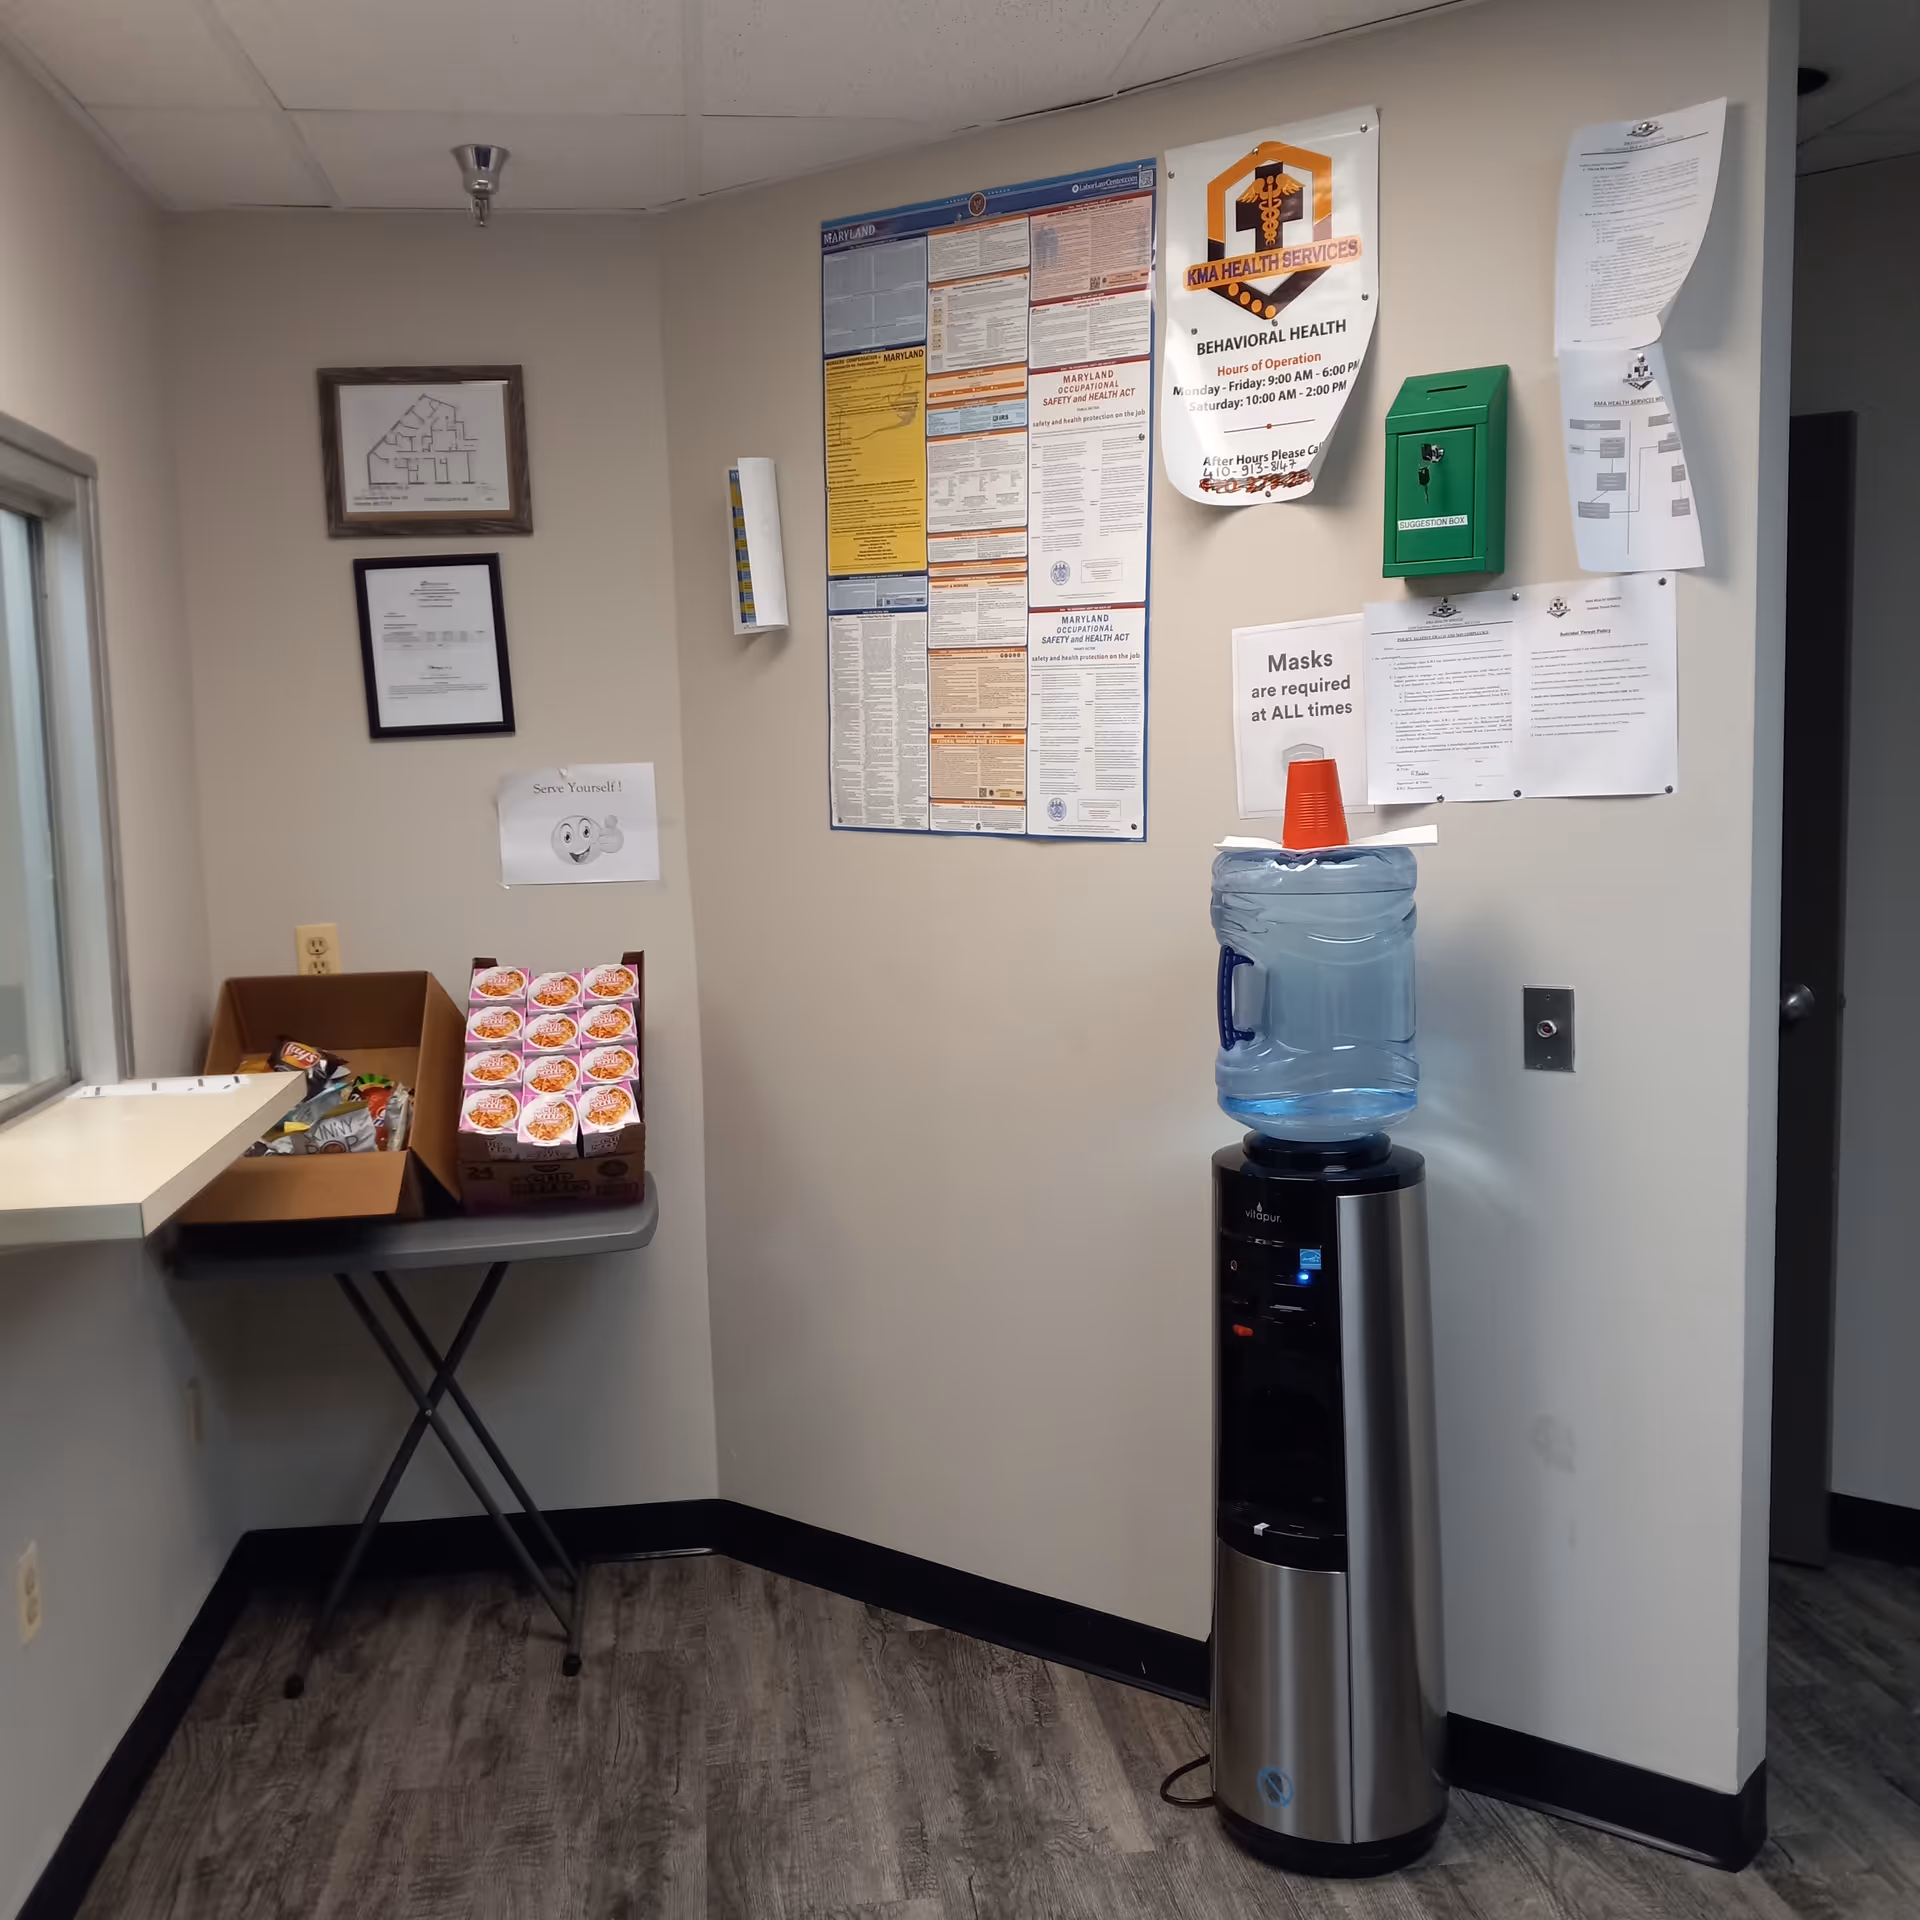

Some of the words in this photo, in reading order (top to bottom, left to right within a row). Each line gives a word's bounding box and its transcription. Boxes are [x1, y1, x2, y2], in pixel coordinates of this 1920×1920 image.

[824, 224, 876, 245] MARYLAND
[1186, 269, 1218, 287] KMA
[1221, 254, 1280, 280] HEALTH
[1282, 239, 1358, 268] SERVICES
[1197, 330, 1286, 356] BEHAVIORAL
[1290, 319, 1347, 341] HEALTH
[883, 349, 924, 362] MARYLAND
[1217, 364, 1249, 377] Hours
[1251, 359, 1264, 371] of
[1265, 352, 1322, 371] Operation
[1063, 370, 1114, 384] MARYLAND
[1228, 377, 1266, 393] Friday:
[1267, 374, 1292, 386] 9:00
[1294, 369, 1313, 382] AM
[1322, 365, 1346, 377] 6:00
[1058, 380, 1119, 394] OCCUPATIONAL
[1188, 396, 1245, 411] Saturday:
[1245, 394, 1276, 406] 10:00
[1278, 389, 1297, 401] AM
[1305, 384, 1330, 396] 2:00
[1332, 379, 1347, 392] PM
[1043, 395, 1072, 406] SAFETY
[1073, 394, 1087, 403] and
[1088, 390, 1118, 401] HEALTH
[1119, 388, 1136, 398] ACT
[1032, 419, 1050, 427] safety
[1051, 417, 1063, 425] and
[1063, 416, 1082, 424] health
[1083, 412, 1114, 422] protection
[1124, 409, 1135, 417] the
[1134, 408, 1146, 418] job
[1202, 456, 1234, 467] After
[1236, 453, 1269, 466] Hours
[1271, 448, 1305, 461] Please
[1307, 441, 1325, 455] Cal
[1398, 518, 1447, 530] SUGGESTION
[1448, 516, 1466, 525] BOX
[1056, 624, 1114, 634] OCCUPATIONAL
[1061, 614, 1109, 625] MARYLAND
[1041, 635, 1070, 645] SAFETY
[1070, 635, 1084, 644] and
[1084, 633, 1113, 643] HEALTH
[1113, 633, 1130, 642] ACT
[1031, 655, 1049, 663] safety
[1061, 654, 1079, 662] health
[1079, 653, 1109, 662] protection
[1128, 652, 1141, 661] job
[1268, 649, 1333, 673] Masks
[1251, 685, 1277, 698] are
[1281, 674, 1351, 697] required
[1251, 707, 1267, 722] at
[1271, 703, 1304, 721] ALL
[1307, 701, 1353, 718] times
[533, 783, 565, 794] Serve
